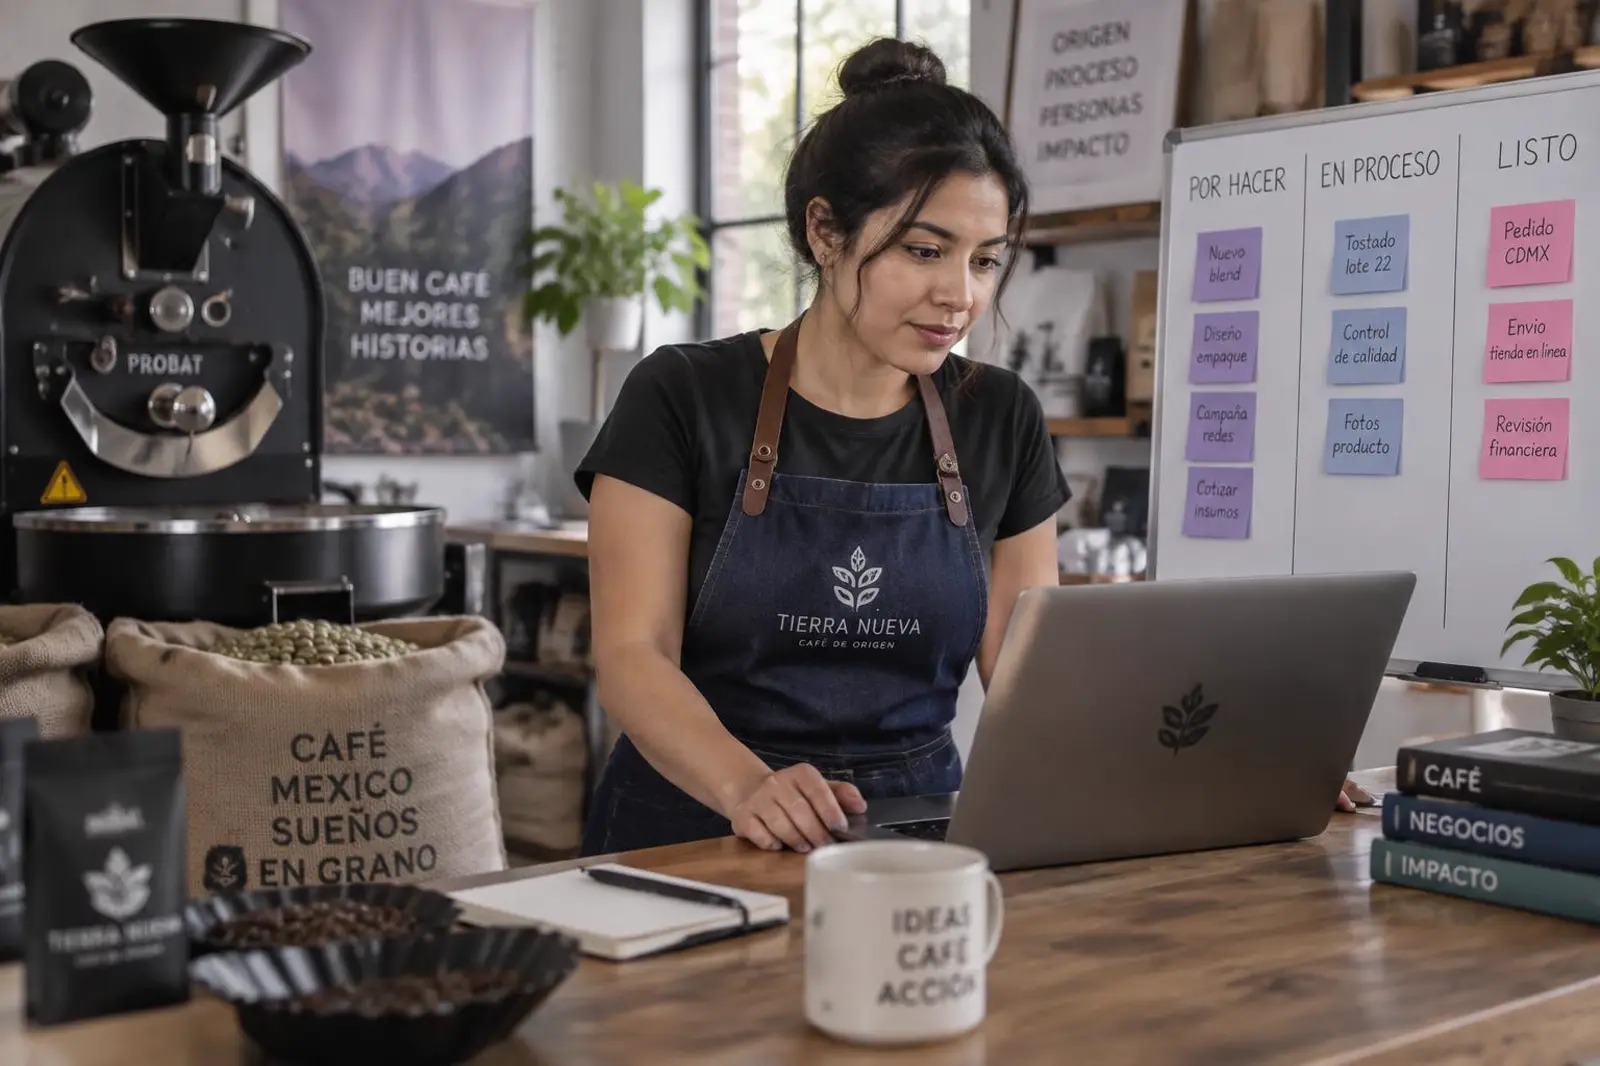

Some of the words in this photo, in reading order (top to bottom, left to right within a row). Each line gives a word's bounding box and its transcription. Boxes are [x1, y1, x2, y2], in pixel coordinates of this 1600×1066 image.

[1051, 20, 1132, 55] ORIGEN
[1044, 55, 1140, 91] PROCESO
[1039, 91, 1143, 127] PERSONAS
[1036, 131, 1130, 162] IMPACTO
[1498, 133, 1577, 170] LISTO
[1320, 160, 1346, 189] EN
[1353, 149, 1441, 184] PROCESO
[1189, 175, 1222, 201] POR
[1228, 166, 1287, 196] HACER
[1504, 216, 1555, 240] Pedido
[1345, 231, 1396, 251] Tostado
[1208, 245, 1246, 261] Nuevo
[1345, 257, 1370, 275] lote
[1374, 254, 1393, 273] 22
[1504, 243, 1551, 265] CDMX
[348, 265, 420, 295] BUEN
[1208, 264, 1242, 283] blend
[360, 299, 481, 330] MEJORES
[1343, 322, 1390, 341] Control
[350, 332, 490, 362] HISTORIAS
[1334, 348, 1349, 364] de
[1352, 346, 1398, 364] calidad
[1488, 343, 1524, 361] tienda
[1526, 349, 1539, 359] en
[127, 352, 204, 375] PROBAT
[1196, 351, 1248, 371] empaque
[1196, 403, 1248, 426] Campaña
[1344, 413, 1380, 431] Fotos
[1496, 414, 1553, 433] Revisión
[1202, 427, 1235, 443] redes
[1332, 437, 1390, 459] producto
[1489, 438, 1557, 458] financiera
[1196, 479, 1239, 498] Cotizar
[1194, 503, 1239, 520] insumos
[777, 612, 849, 635] TIERRA
[856, 617, 921, 636] NUEVA
[798, 637, 828, 649] CAFÉ
[832, 639, 848, 649] DE
[852, 640, 896, 651] ORIGEN
[290, 721, 387, 763] CAFÉ
[270, 766, 414, 805] MEXICO
[1423, 764, 1483, 793] CAFÉ
[271, 806, 419, 847] SUEÑOS
[1409, 810, 1525, 850] NEGOCIOS
[259, 857, 305, 888] EN
[317, 843, 438, 886] GRANO
[1401, 855, 1499, 893] IMPACTO
